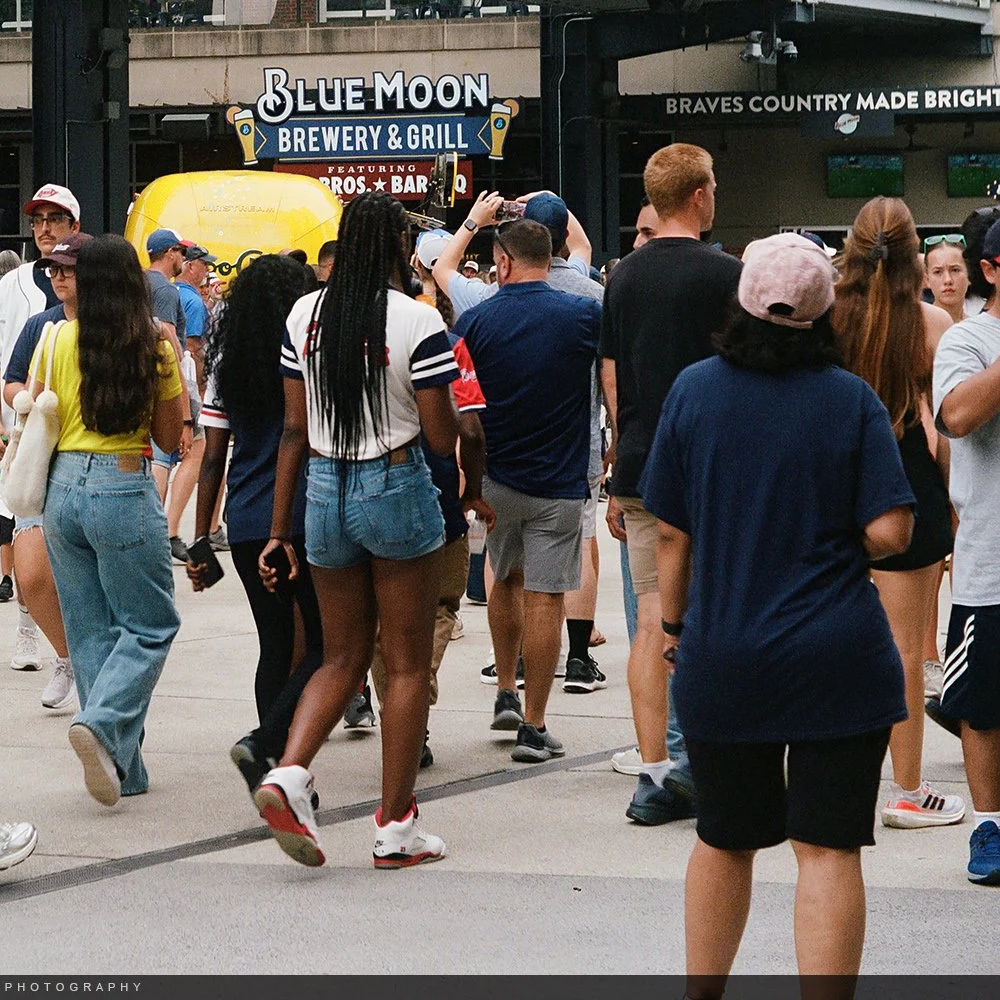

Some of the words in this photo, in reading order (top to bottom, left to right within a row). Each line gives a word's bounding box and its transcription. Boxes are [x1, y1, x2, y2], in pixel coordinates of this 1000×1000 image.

[257, 67, 366, 124] BLUE
[372, 70, 489, 109] MOON
[666, 96, 743, 115] BRAVES
[749, 92, 851, 113] COUNTRY
[856, 90, 919, 111] MADE
[278, 125, 381, 153] BREWERY
[387, 123, 403, 151] &
[407, 122, 469, 149] GRILL
[327, 164, 417, 174] FEATURING
